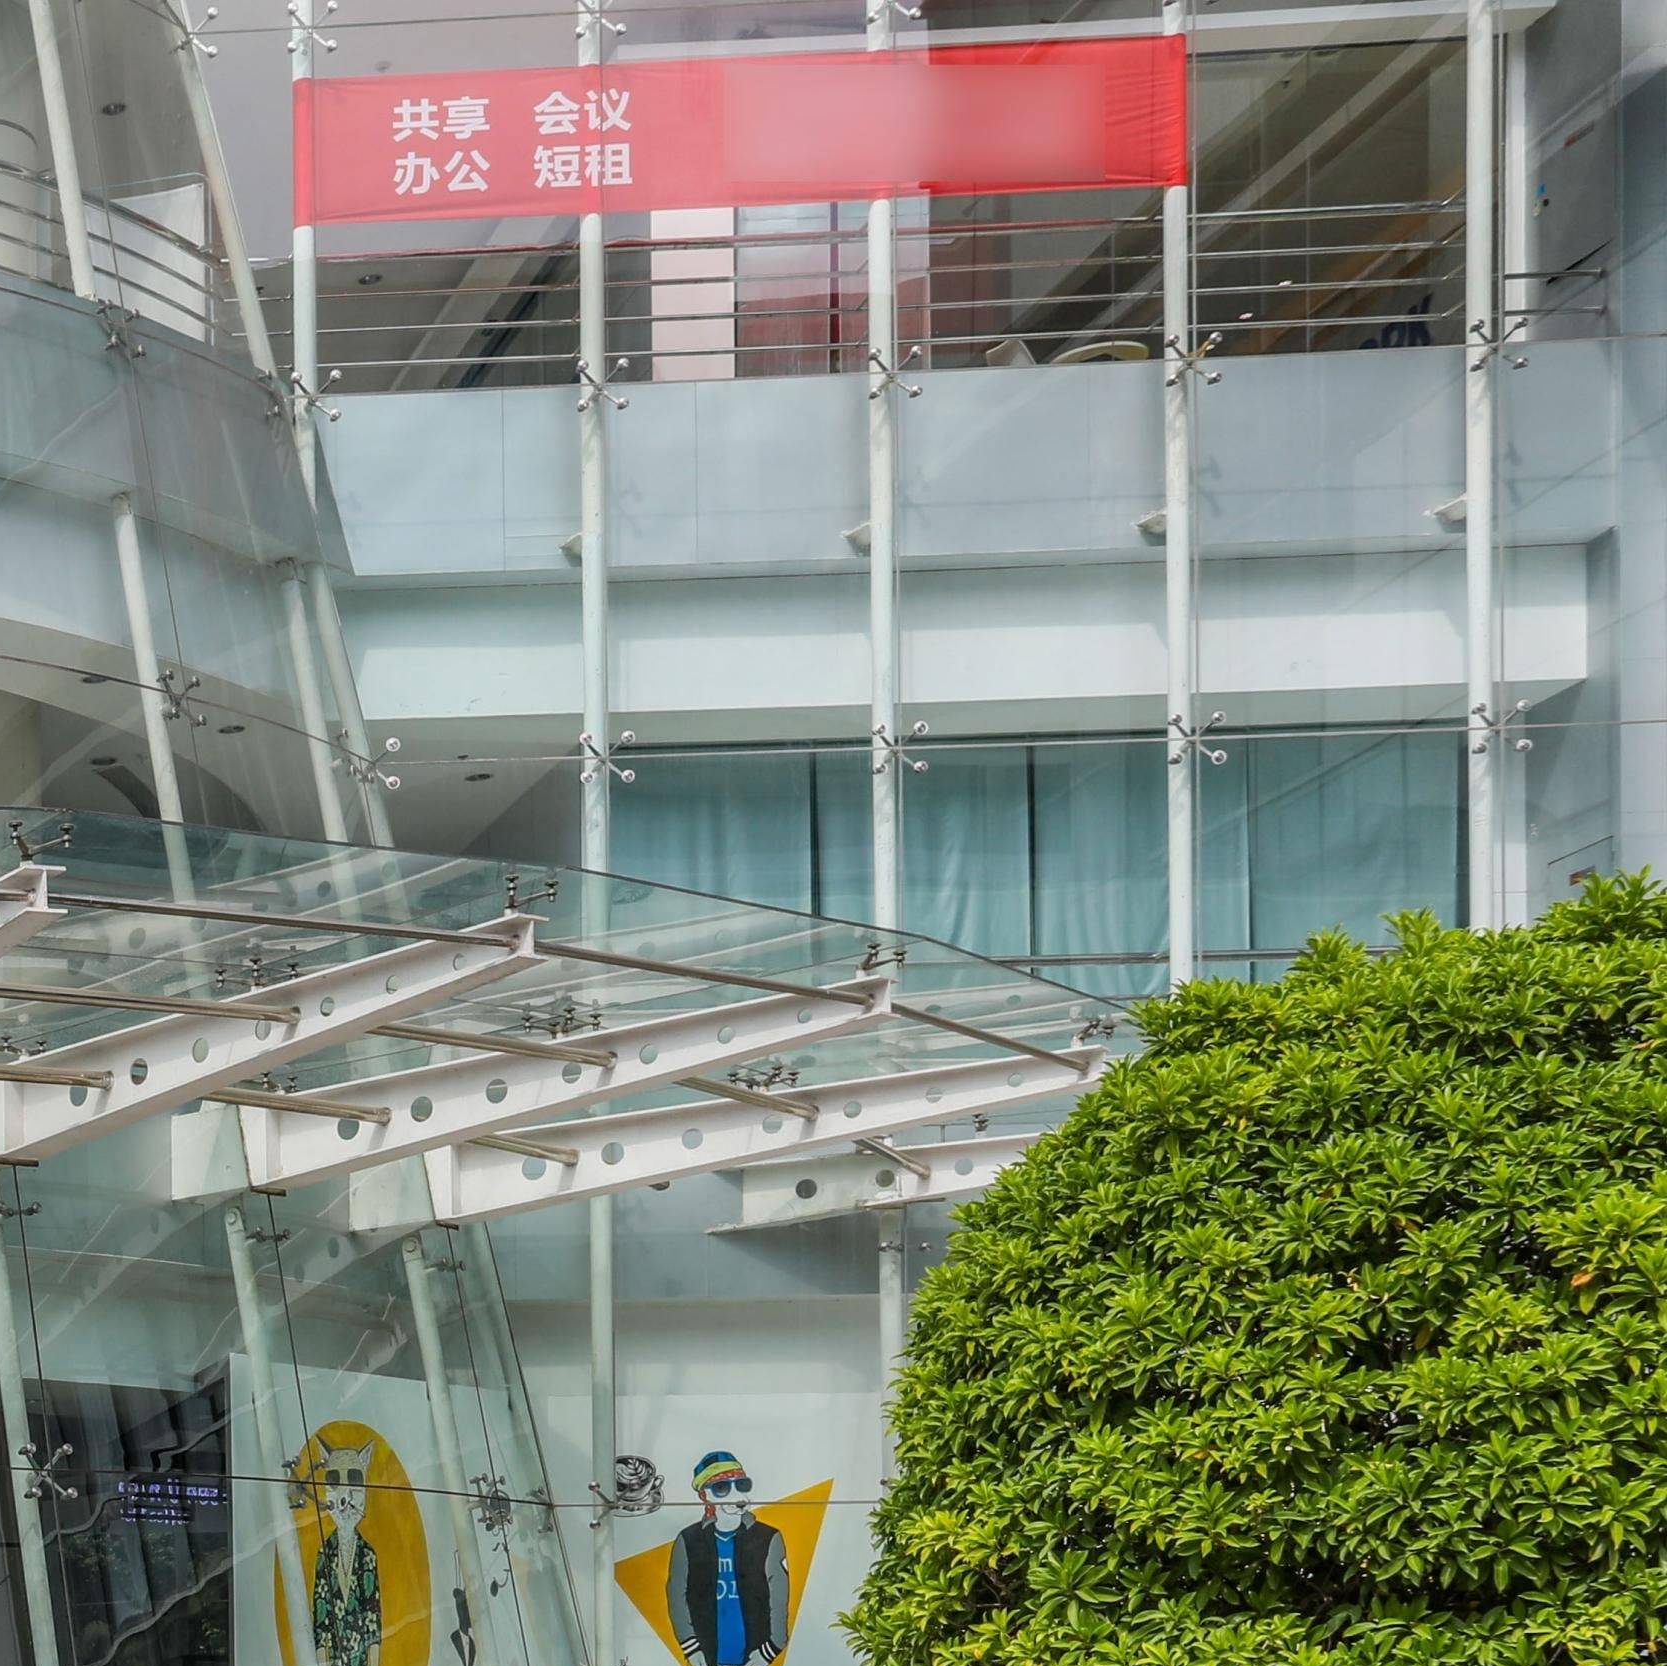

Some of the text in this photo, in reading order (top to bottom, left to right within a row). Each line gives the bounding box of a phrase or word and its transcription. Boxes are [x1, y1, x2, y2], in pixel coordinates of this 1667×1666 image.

[393, 88, 633, 142] 共享 会议
[393, 142, 633, 195] 办公 短租
